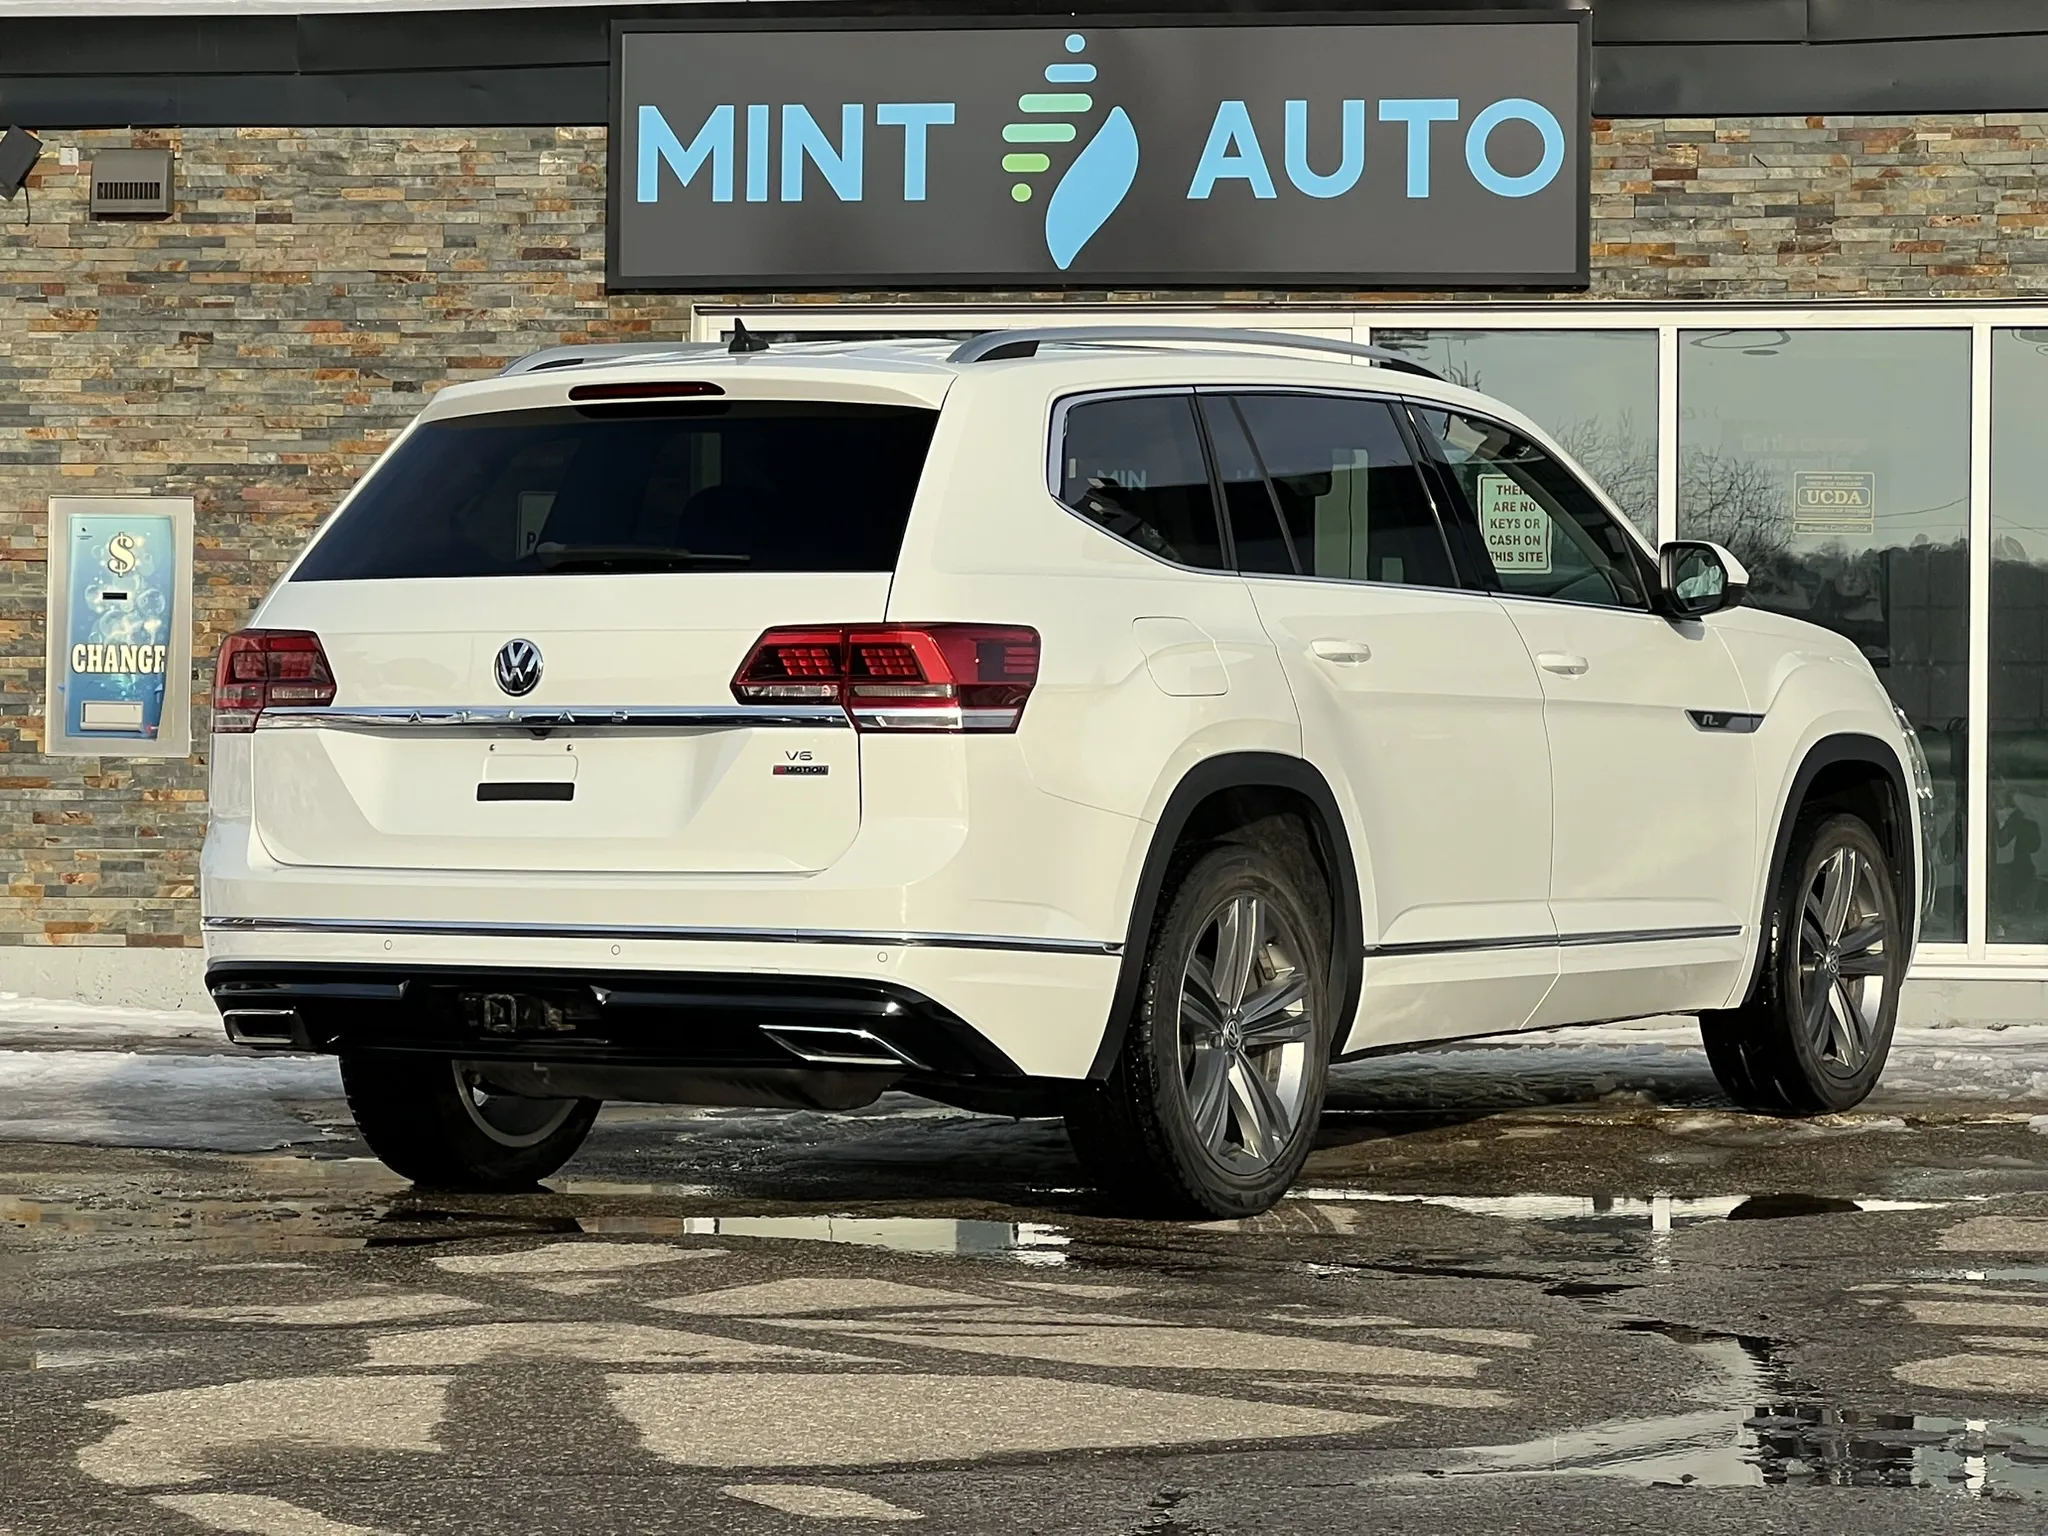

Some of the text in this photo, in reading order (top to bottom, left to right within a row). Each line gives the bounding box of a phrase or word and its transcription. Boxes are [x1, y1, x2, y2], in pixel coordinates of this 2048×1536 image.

[636, 97, 1566, 203] MINT AUTO
[1496, 485, 1529, 496] THE
[1806, 490, 1862, 505] UCDA
[1493, 501, 1536, 512] ARE NO
[1490, 518, 1540, 529] KEYS OR
[1489, 535, 1541, 546] CASH ON
[1490, 551, 1543, 562] THIS SITE
[785, 751, 813, 761] V6
